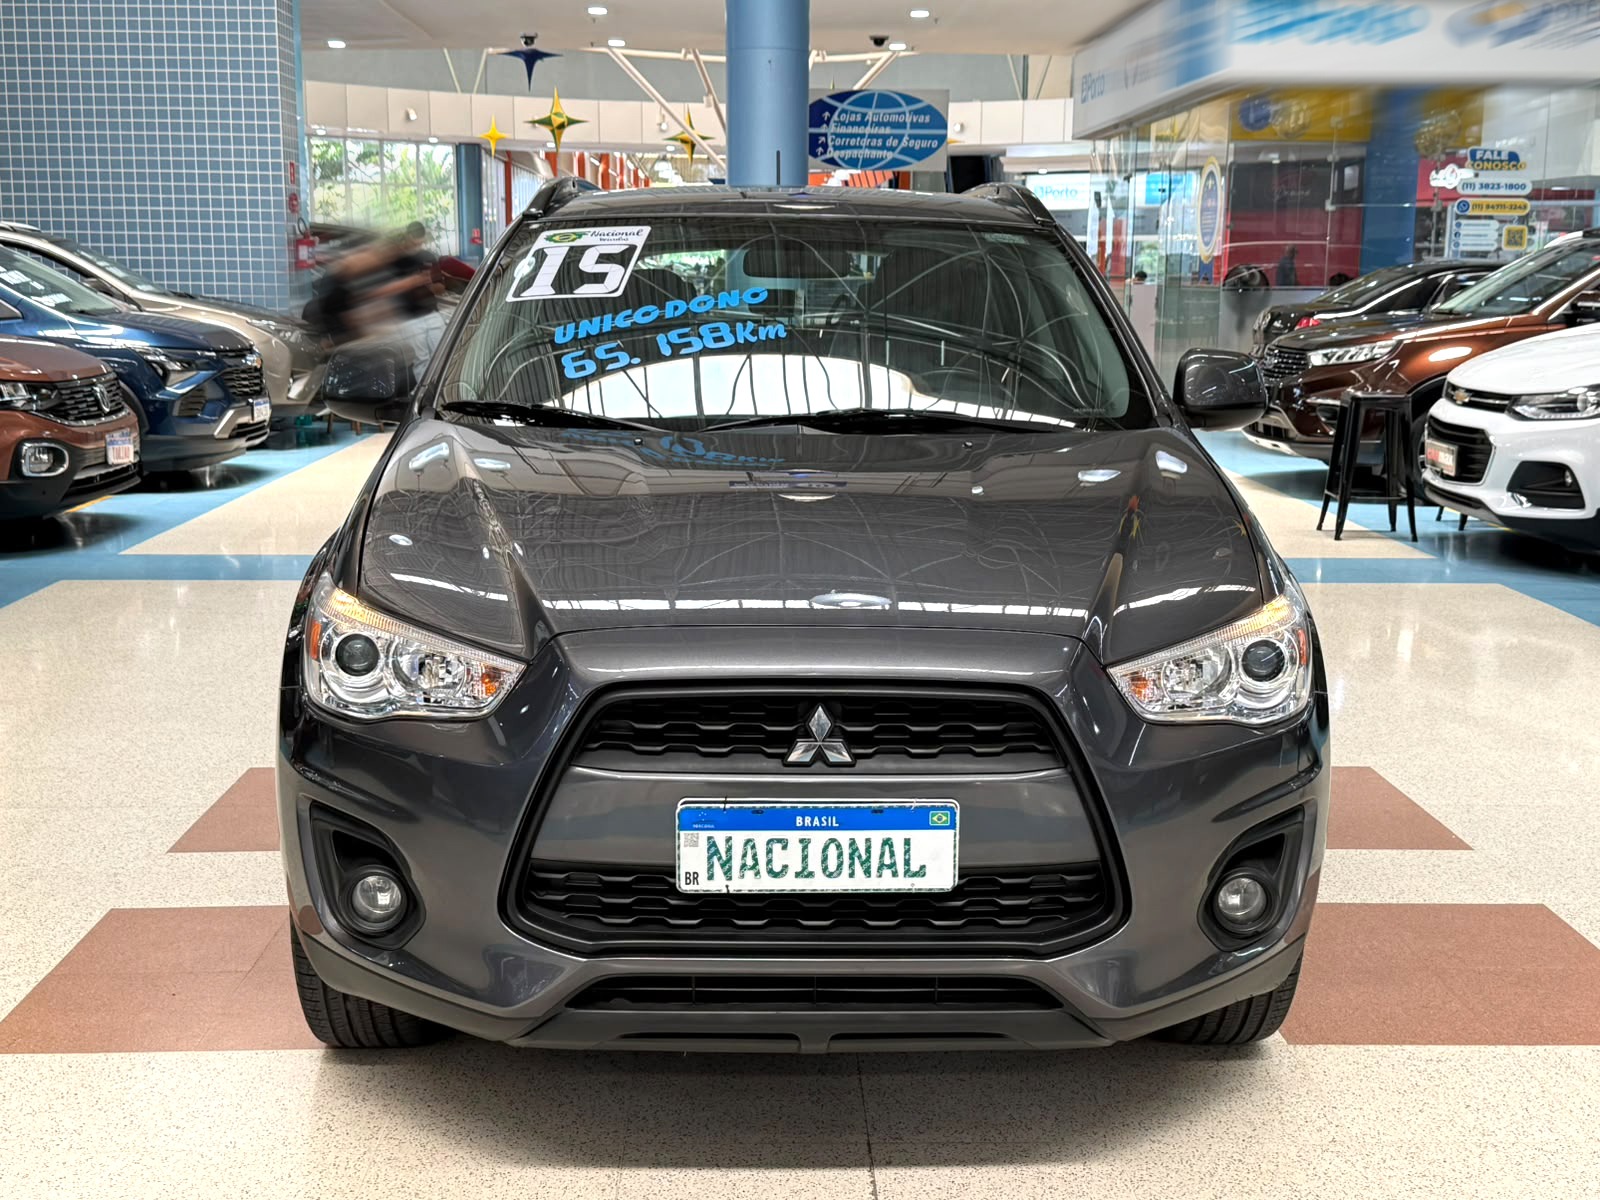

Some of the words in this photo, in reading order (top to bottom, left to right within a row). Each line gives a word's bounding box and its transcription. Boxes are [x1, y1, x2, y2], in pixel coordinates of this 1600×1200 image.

[833, 110, 862, 124] Lojas
[865, 111, 930, 123] Automotivas
[831, 122, 892, 134] Financeiras
[829, 135, 883, 147] Corretoras
[886, 136, 899, 147] de
[902, 137, 939, 149] Seguro
[826, 148, 893, 160] Despachante
[1465, 161, 1526, 170] CONOSCO
[1045, 185, 1078, 198] Porto
[590, 229, 644, 238] Nacional
[795, 815, 840, 828] BRASIL
[706, 836, 927, 881] NACIONAL
[684, 871, 700, 886] BR
